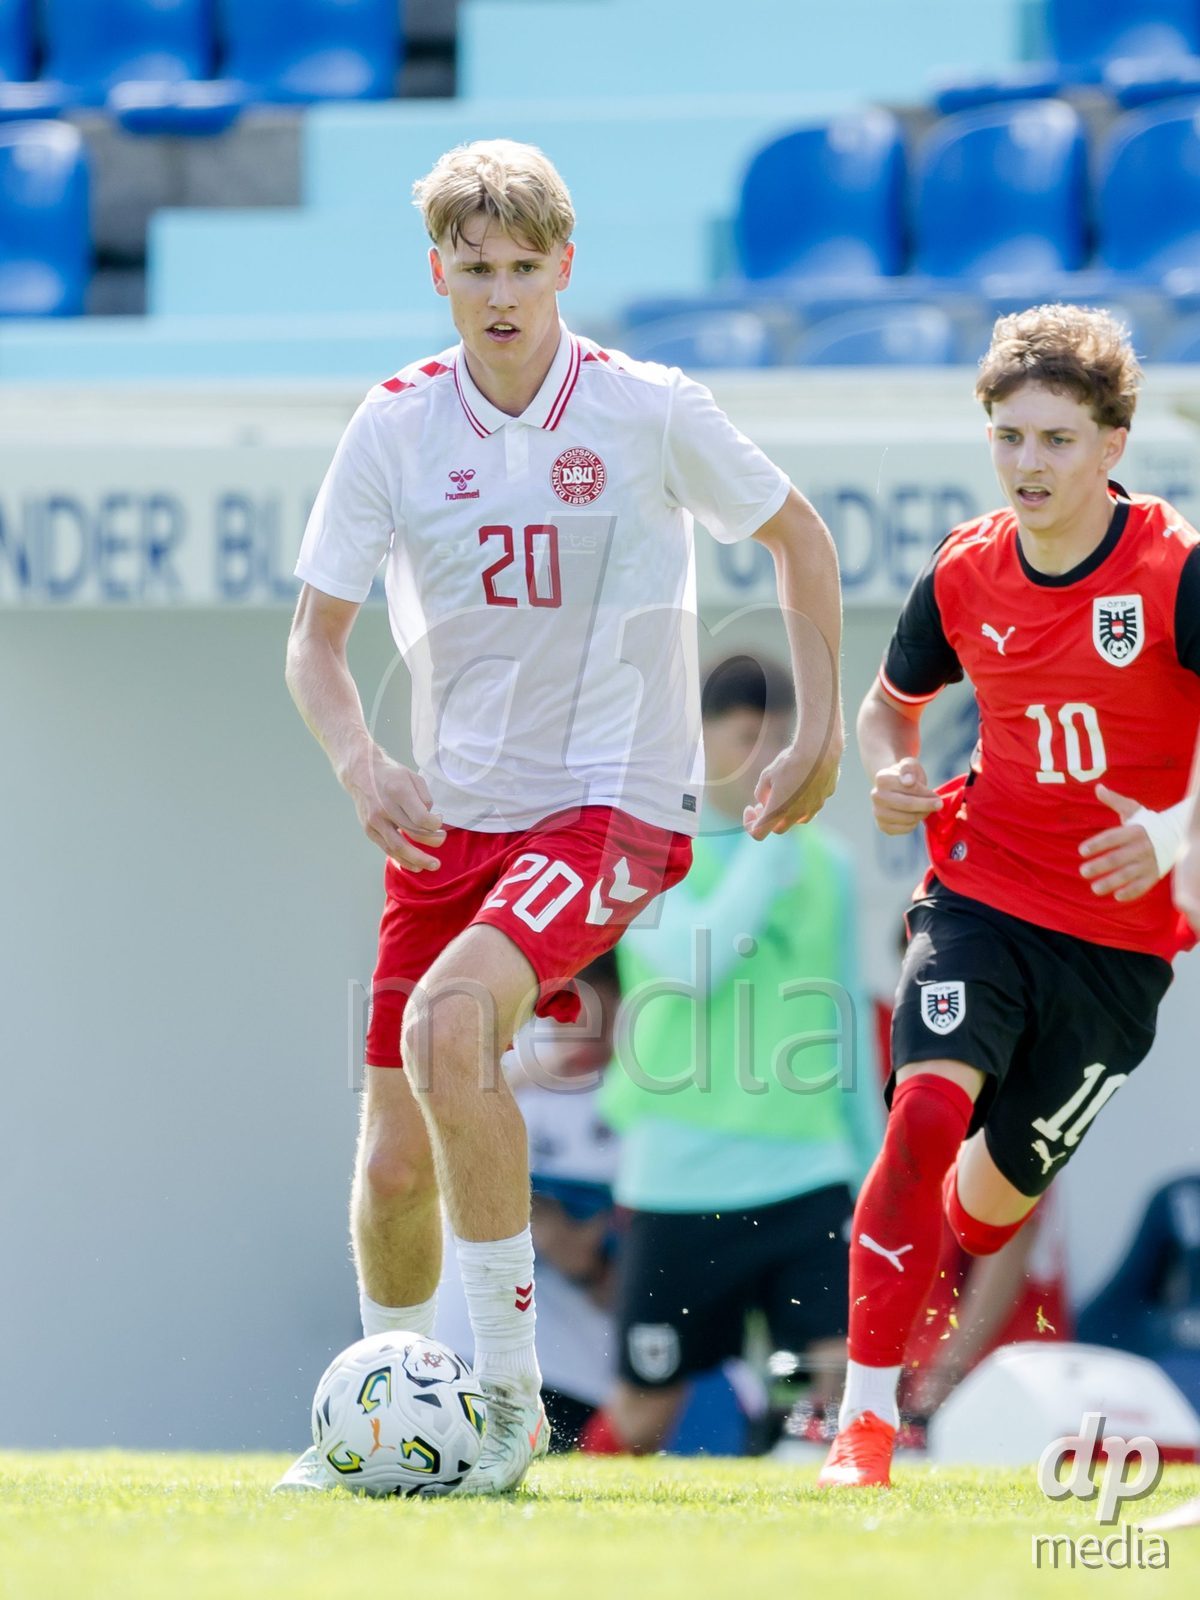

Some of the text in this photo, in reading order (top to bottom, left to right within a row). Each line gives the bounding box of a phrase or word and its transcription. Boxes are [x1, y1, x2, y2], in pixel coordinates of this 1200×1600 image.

[562, 466, 594, 485] DBU
[591, 464, 605, 496] UNION
[445, 489, 480, 501] hummel
[568, 496, 591, 504] 1889
[478, 524, 562, 608] 20
[1025, 702, 1108, 784] 10
[482, 852, 585, 933] 20
